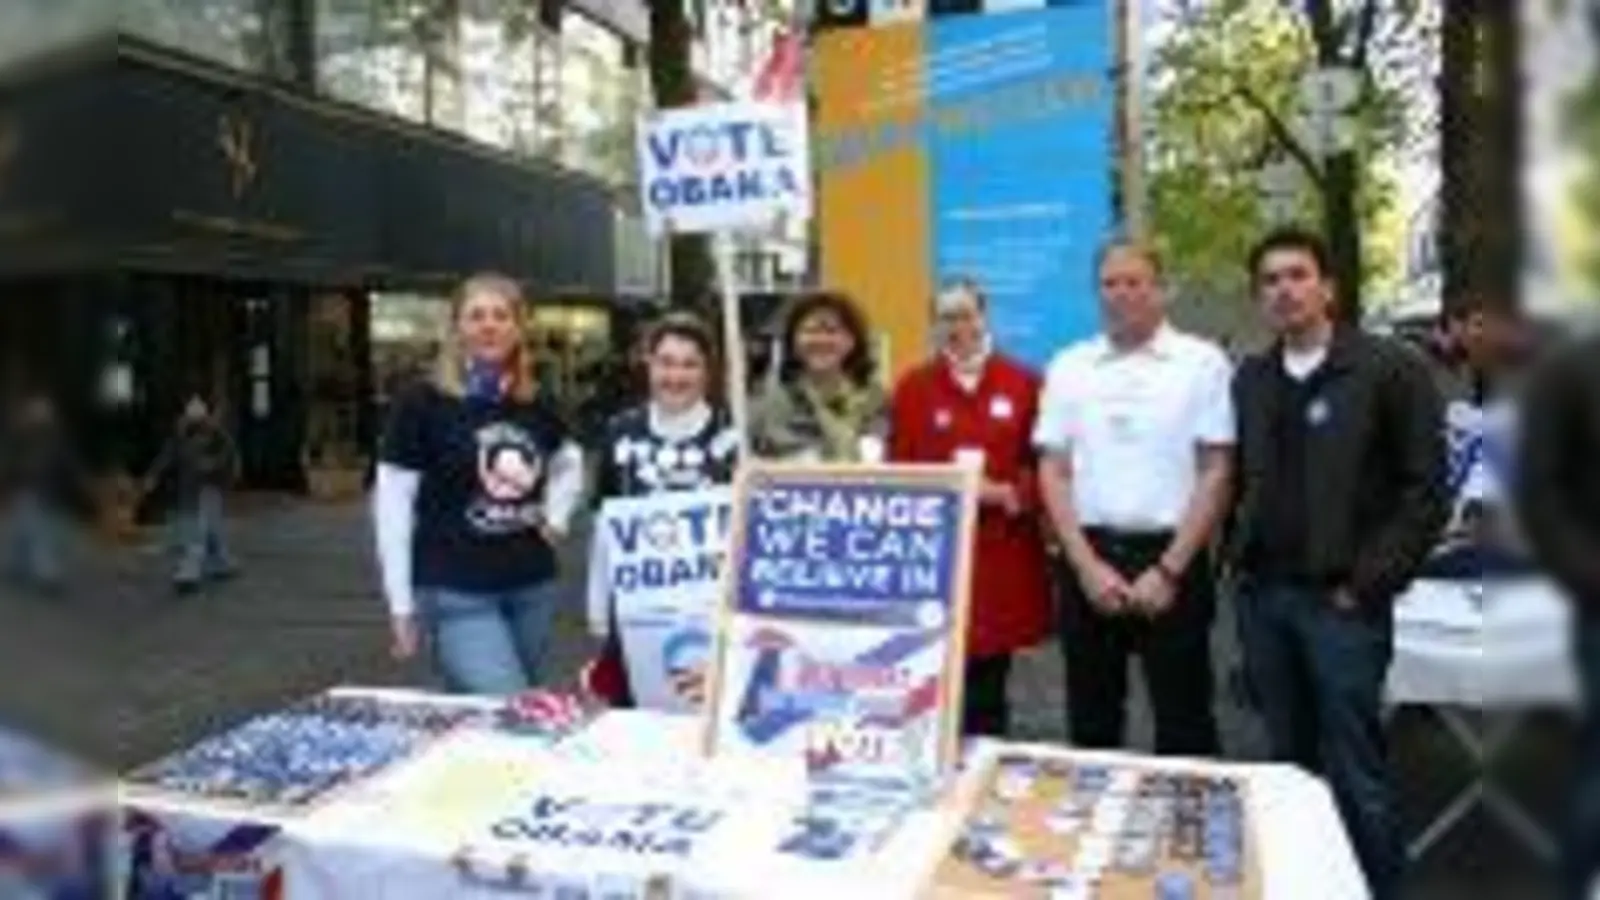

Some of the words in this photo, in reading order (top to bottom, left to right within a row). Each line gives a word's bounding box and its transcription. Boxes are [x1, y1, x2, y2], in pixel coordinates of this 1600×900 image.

[648, 121, 791, 169] VOTE
[649, 165, 800, 212] OBAMA
[759, 488, 944, 526] CHANGE
[756, 524, 829, 560] WE
[845, 530, 942, 562] CAN
[900, 564, 939, 594] IN
